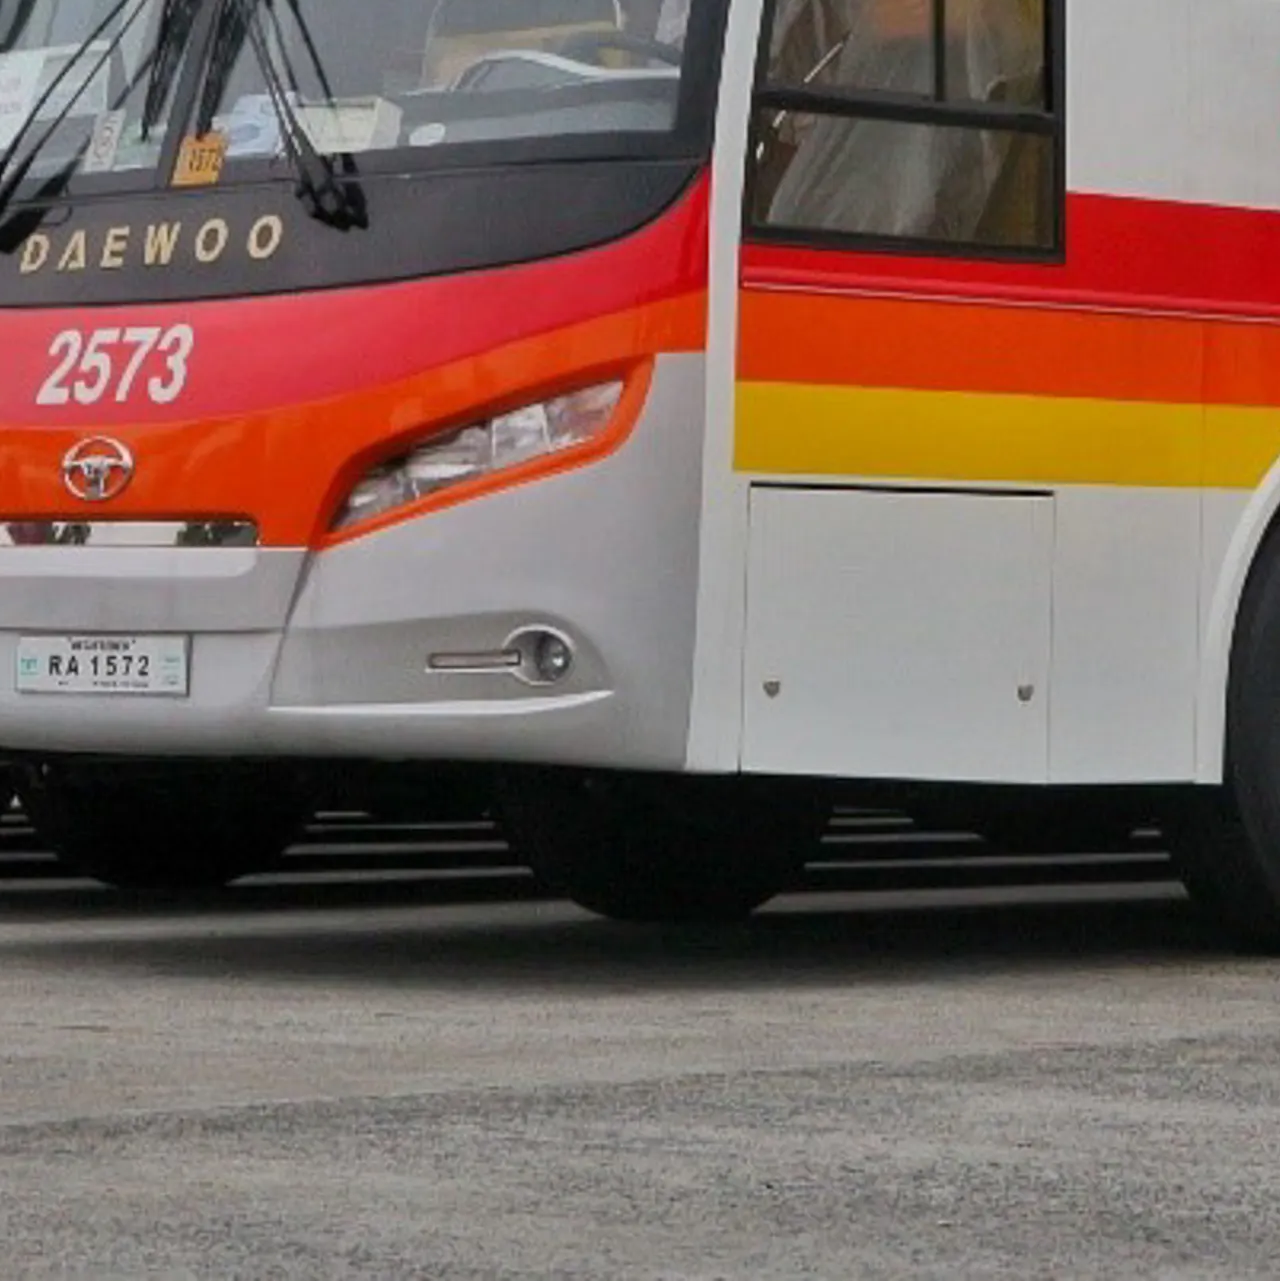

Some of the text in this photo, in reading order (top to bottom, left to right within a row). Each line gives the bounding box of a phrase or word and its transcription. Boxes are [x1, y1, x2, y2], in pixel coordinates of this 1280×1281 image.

[20, 215, 283, 273] DAEWOO
[35, 323, 194, 405] 2573
[48, 655, 80, 677] RA
[90, 654, 150, 677] 1572
